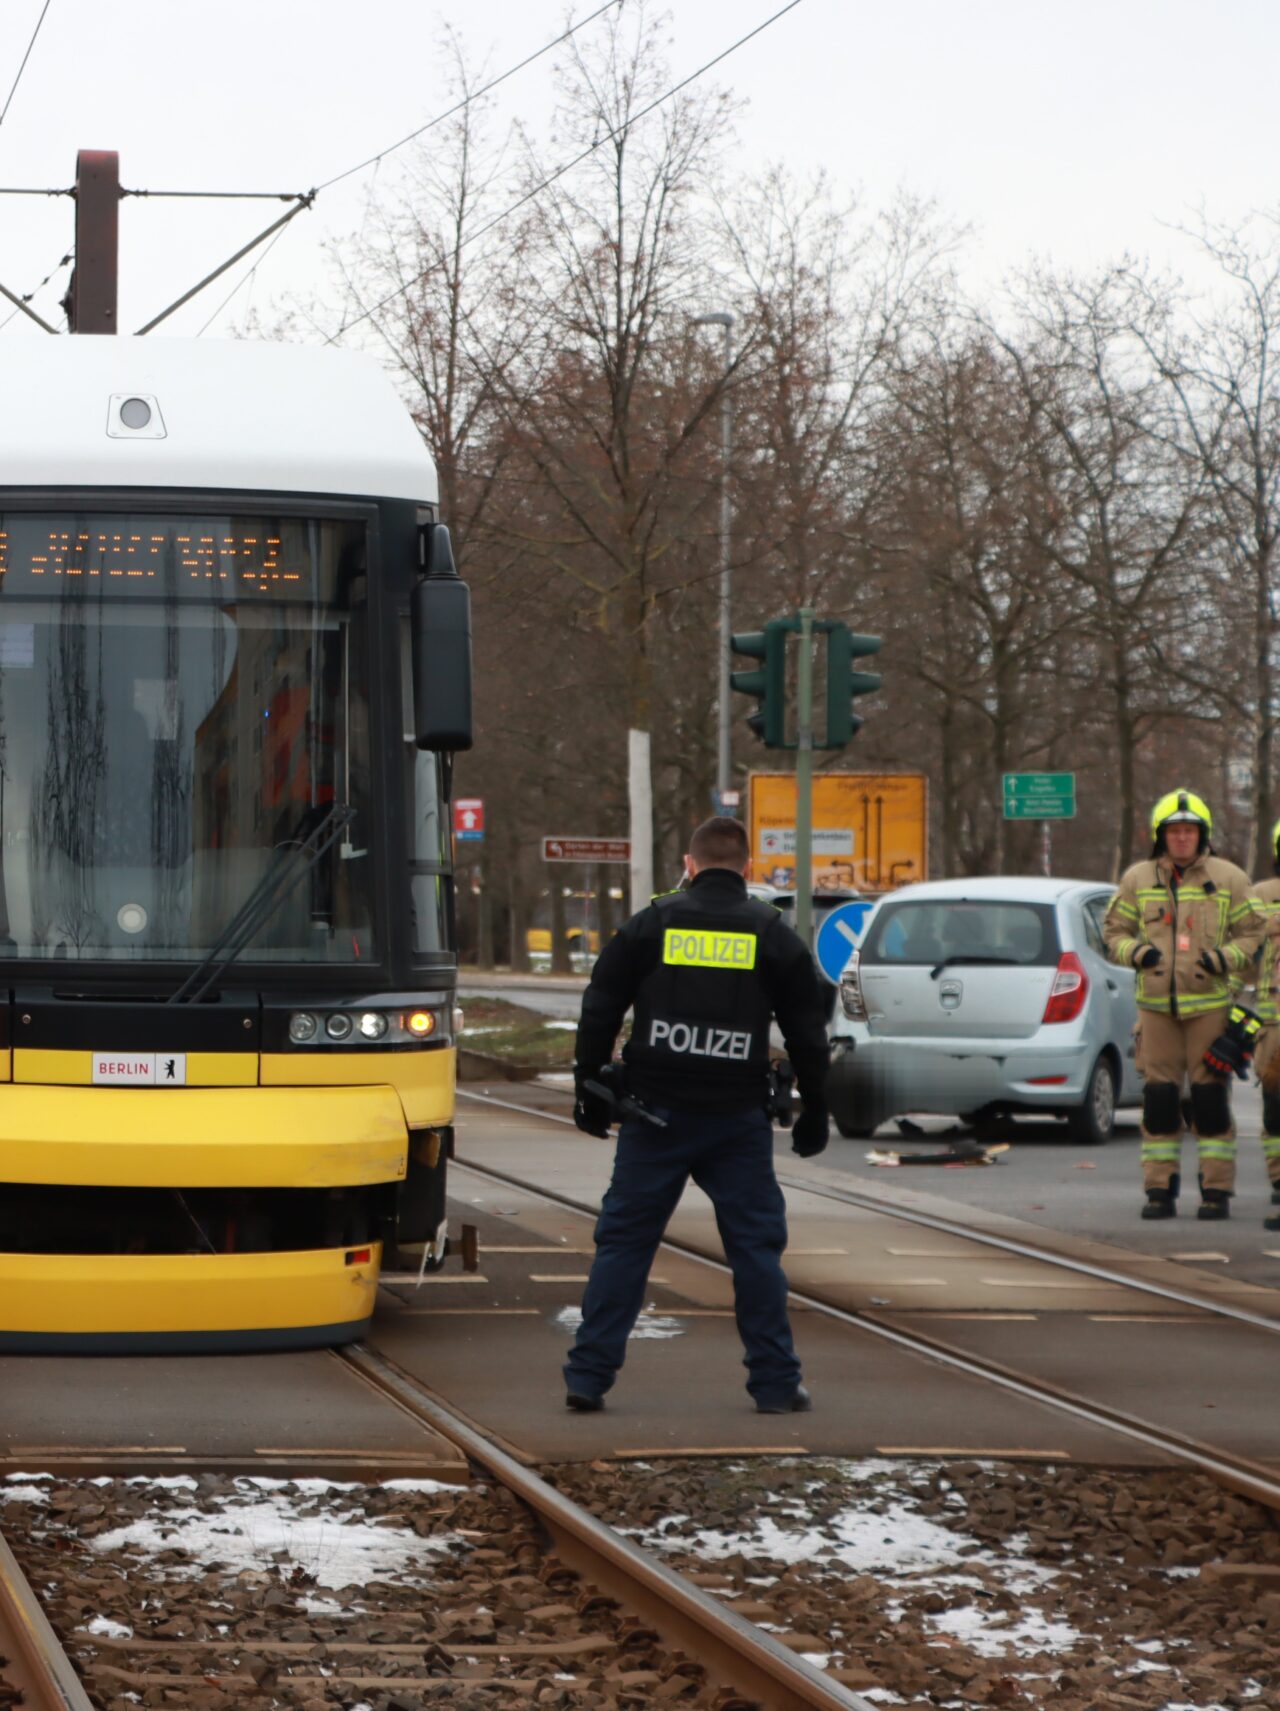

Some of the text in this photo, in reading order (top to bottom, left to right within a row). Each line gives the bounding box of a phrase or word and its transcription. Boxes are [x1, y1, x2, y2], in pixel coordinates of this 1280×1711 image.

[669, 934, 752, 964] POLIZEI
[649, 1019, 752, 1060] POLIZEI
[99, 1062, 149, 1075] BERLIN
